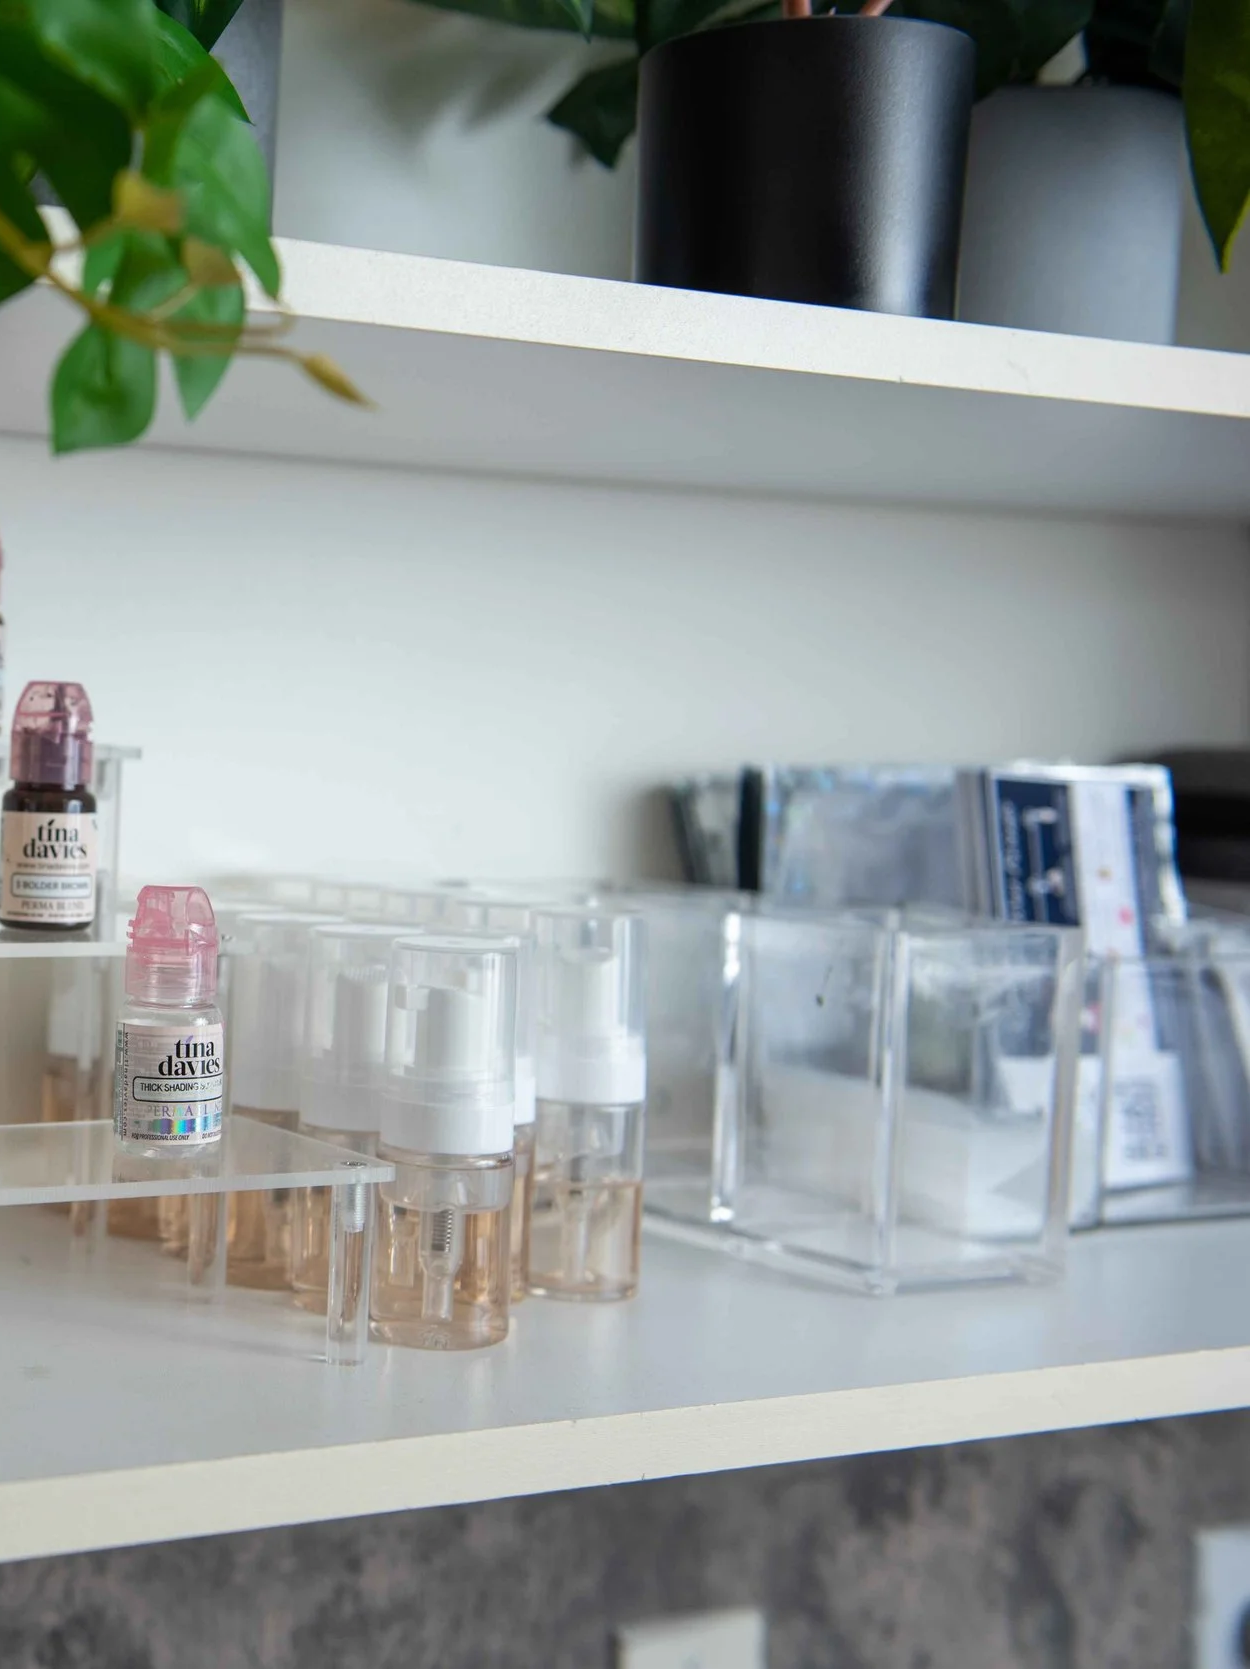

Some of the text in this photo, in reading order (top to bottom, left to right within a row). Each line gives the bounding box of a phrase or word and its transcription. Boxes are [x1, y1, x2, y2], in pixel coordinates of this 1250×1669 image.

[23, 838, 87, 859] davies
[158, 1055, 220, 1076] davies
[140, 1083, 163, 1092] THICK
[164, 1082, 199, 1092] SHADING
